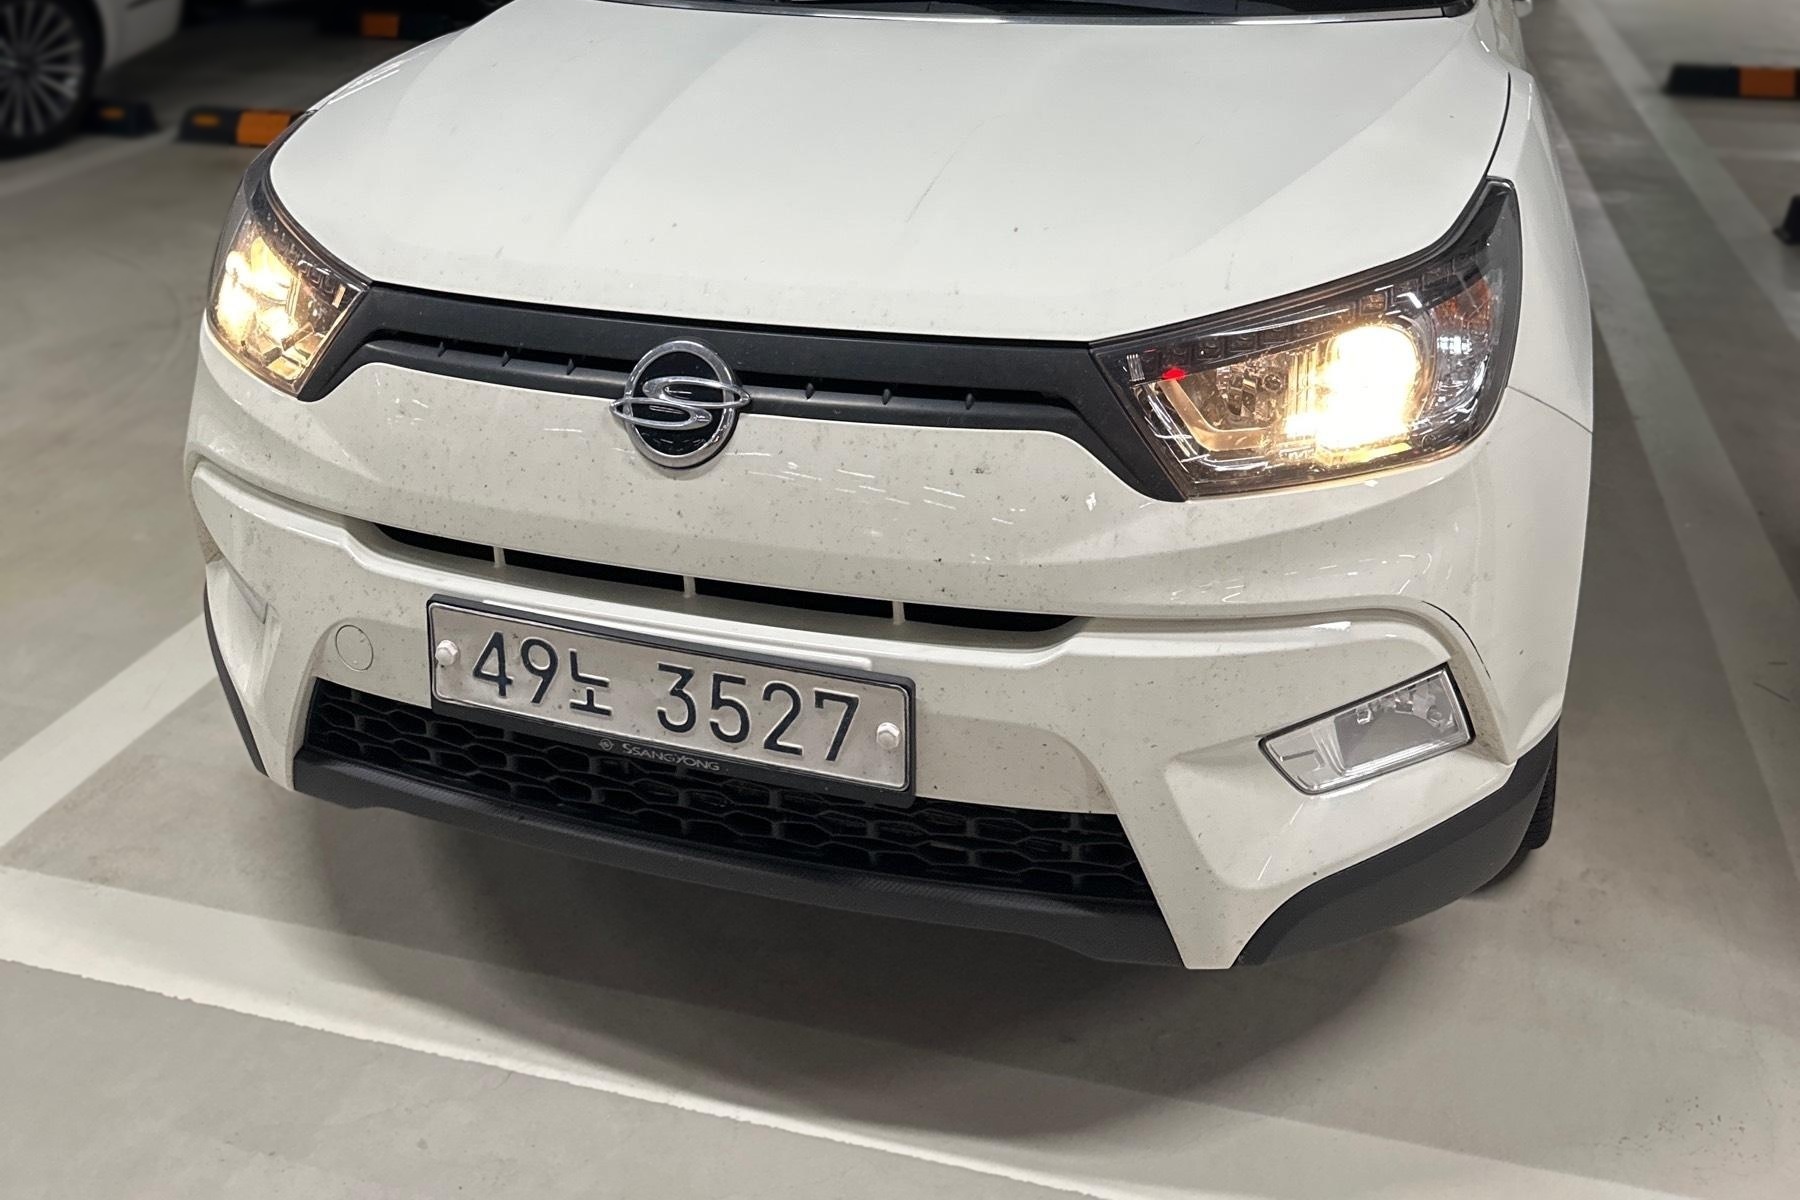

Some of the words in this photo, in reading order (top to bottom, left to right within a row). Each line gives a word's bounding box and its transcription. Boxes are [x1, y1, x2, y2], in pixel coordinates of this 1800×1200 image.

[472, 631, 612, 718] 49노
[656, 662, 860, 762] 3527
[621, 743, 721, 771] SSANGYONG
